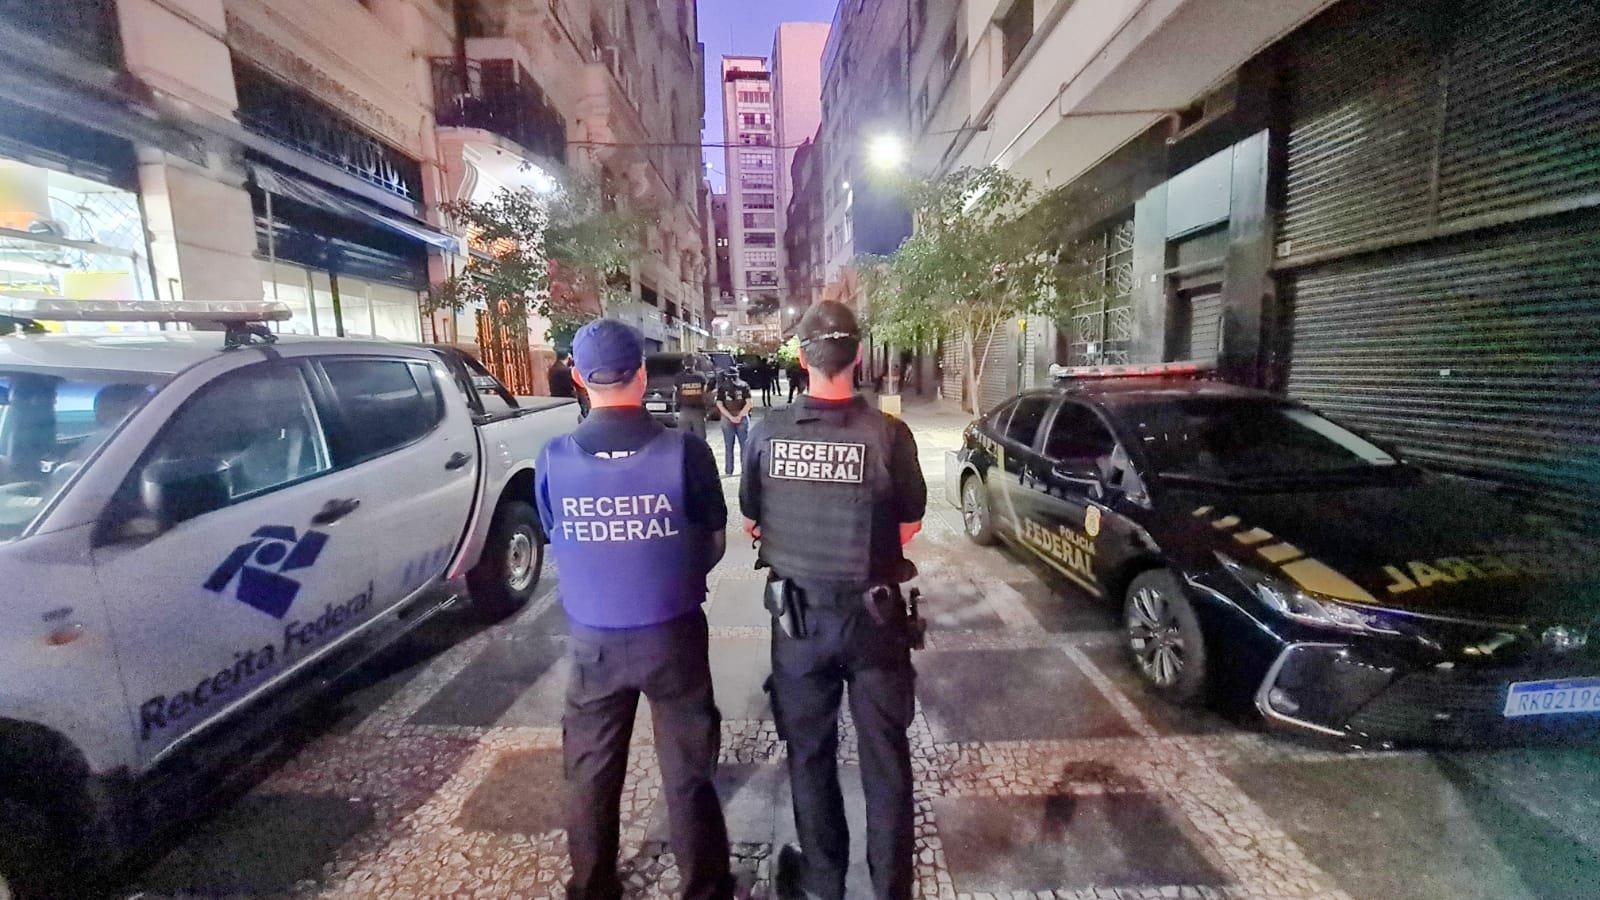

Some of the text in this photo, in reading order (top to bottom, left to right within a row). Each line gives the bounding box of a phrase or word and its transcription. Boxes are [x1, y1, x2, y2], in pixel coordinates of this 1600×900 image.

[774, 442, 860, 463] RECEITA
[773, 460, 859, 480] FEDERAL
[561, 494, 673, 517] RECEITA
[562, 517, 679, 541] FEDERAL
[1024, 517, 1097, 582] FEDERAL
[140, 579, 374, 740] Receita Federal
